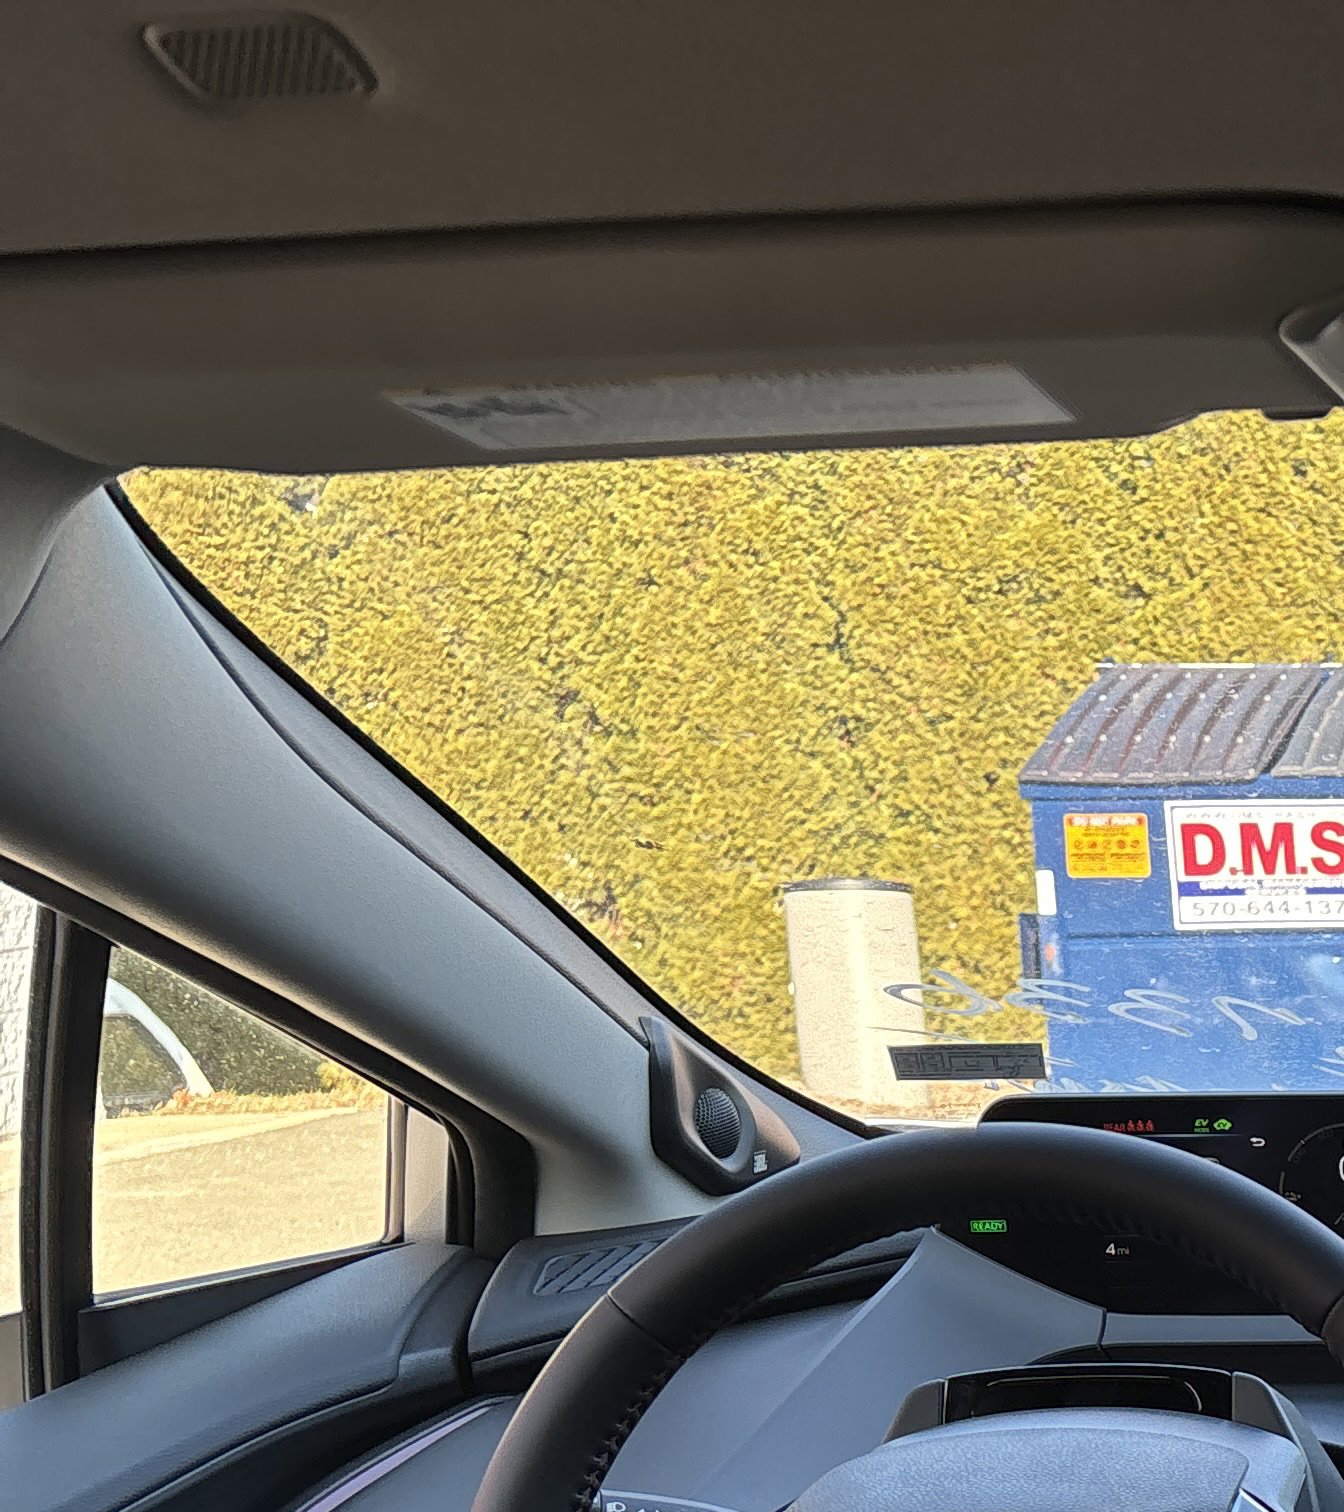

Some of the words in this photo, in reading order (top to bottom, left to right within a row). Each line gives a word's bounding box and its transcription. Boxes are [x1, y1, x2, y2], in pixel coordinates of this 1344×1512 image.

[972, 1221, 1005, 1231] READY
[1105, 1243, 1115, 1255] 4
[1117, 1245, 1130, 1255] mi
